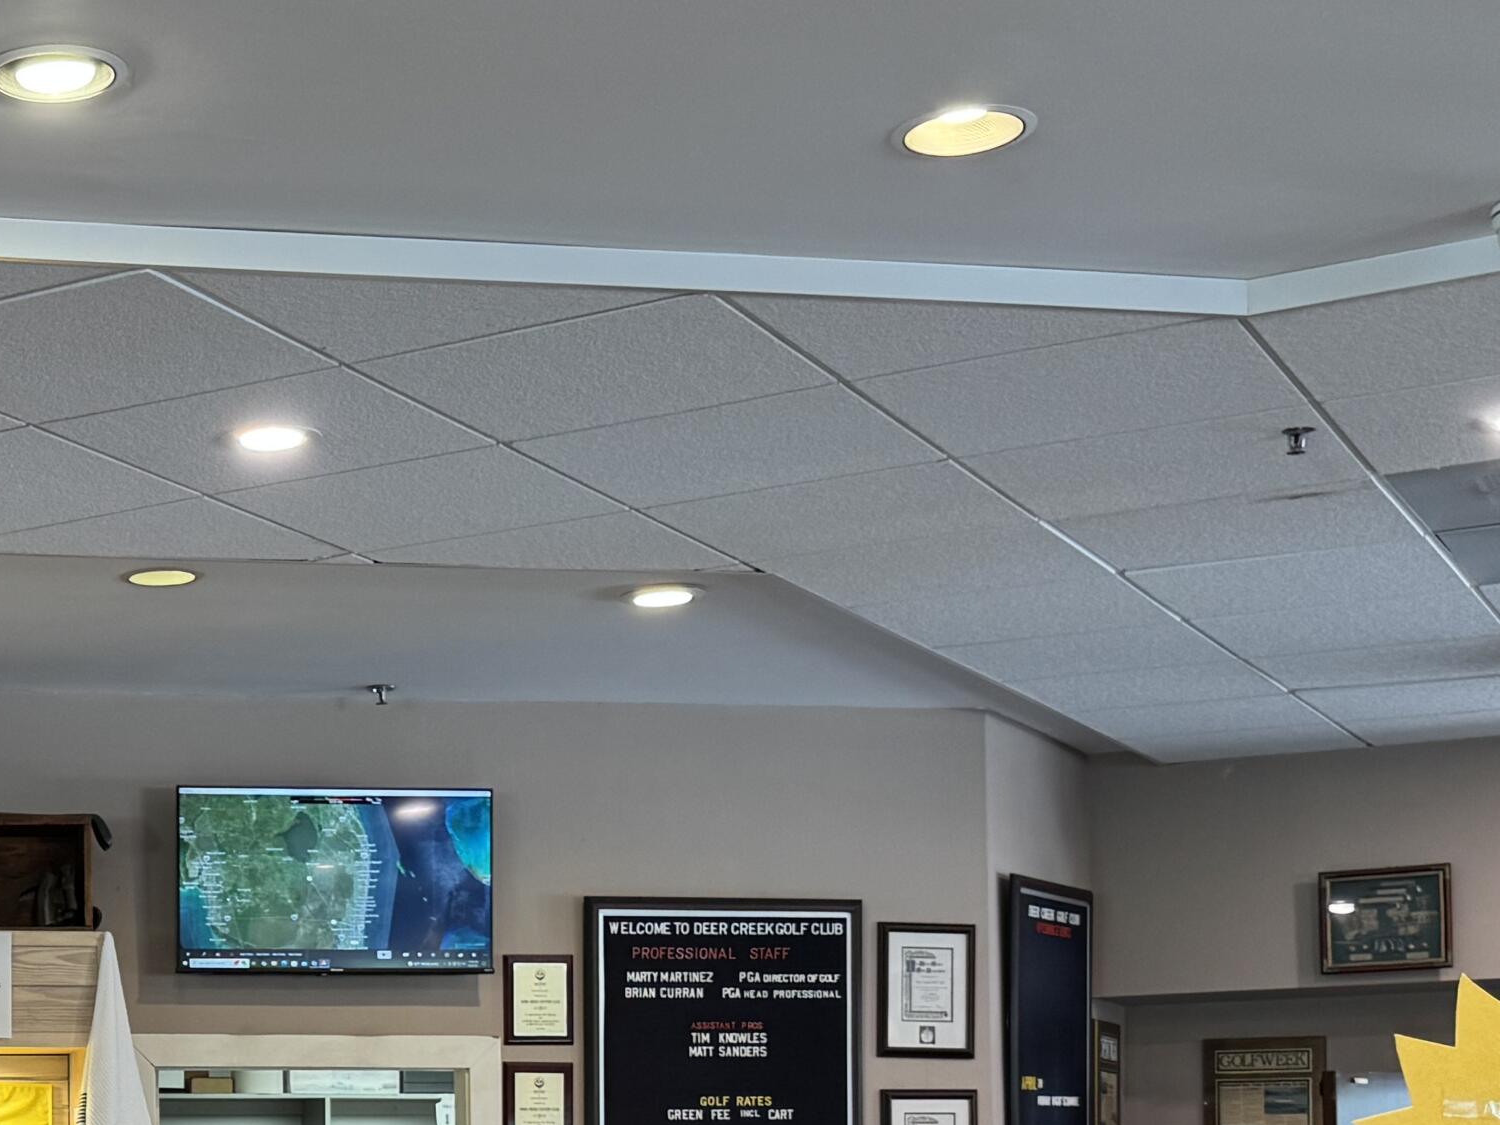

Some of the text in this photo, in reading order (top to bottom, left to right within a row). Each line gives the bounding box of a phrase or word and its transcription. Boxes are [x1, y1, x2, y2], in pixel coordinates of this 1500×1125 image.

[609, 922, 843, 936] WELCOME TO DEER CREEK GOLF CLUB
[632, 947, 790, 960] PROFESSIONAL STAFF
[626, 971, 841, 983] MARTY MARTINEZ PGA DIRECTOR OF GOLF
[625, 987, 841, 999] BRIAN CURRAN PGA HEAD PROFESSIONAL
[691, 1022, 736, 1030] ASSISTANT
[691, 1032, 768, 1044] TIM KNOWLES
[689, 1046, 768, 1057] MATT SANDERS
[1219, 1052, 1307, 1068] GOLFWEEK
[700, 1096, 772, 1106] GOLF RATES
[667, 1109, 794, 1120] GREEN FEE INCL CART
